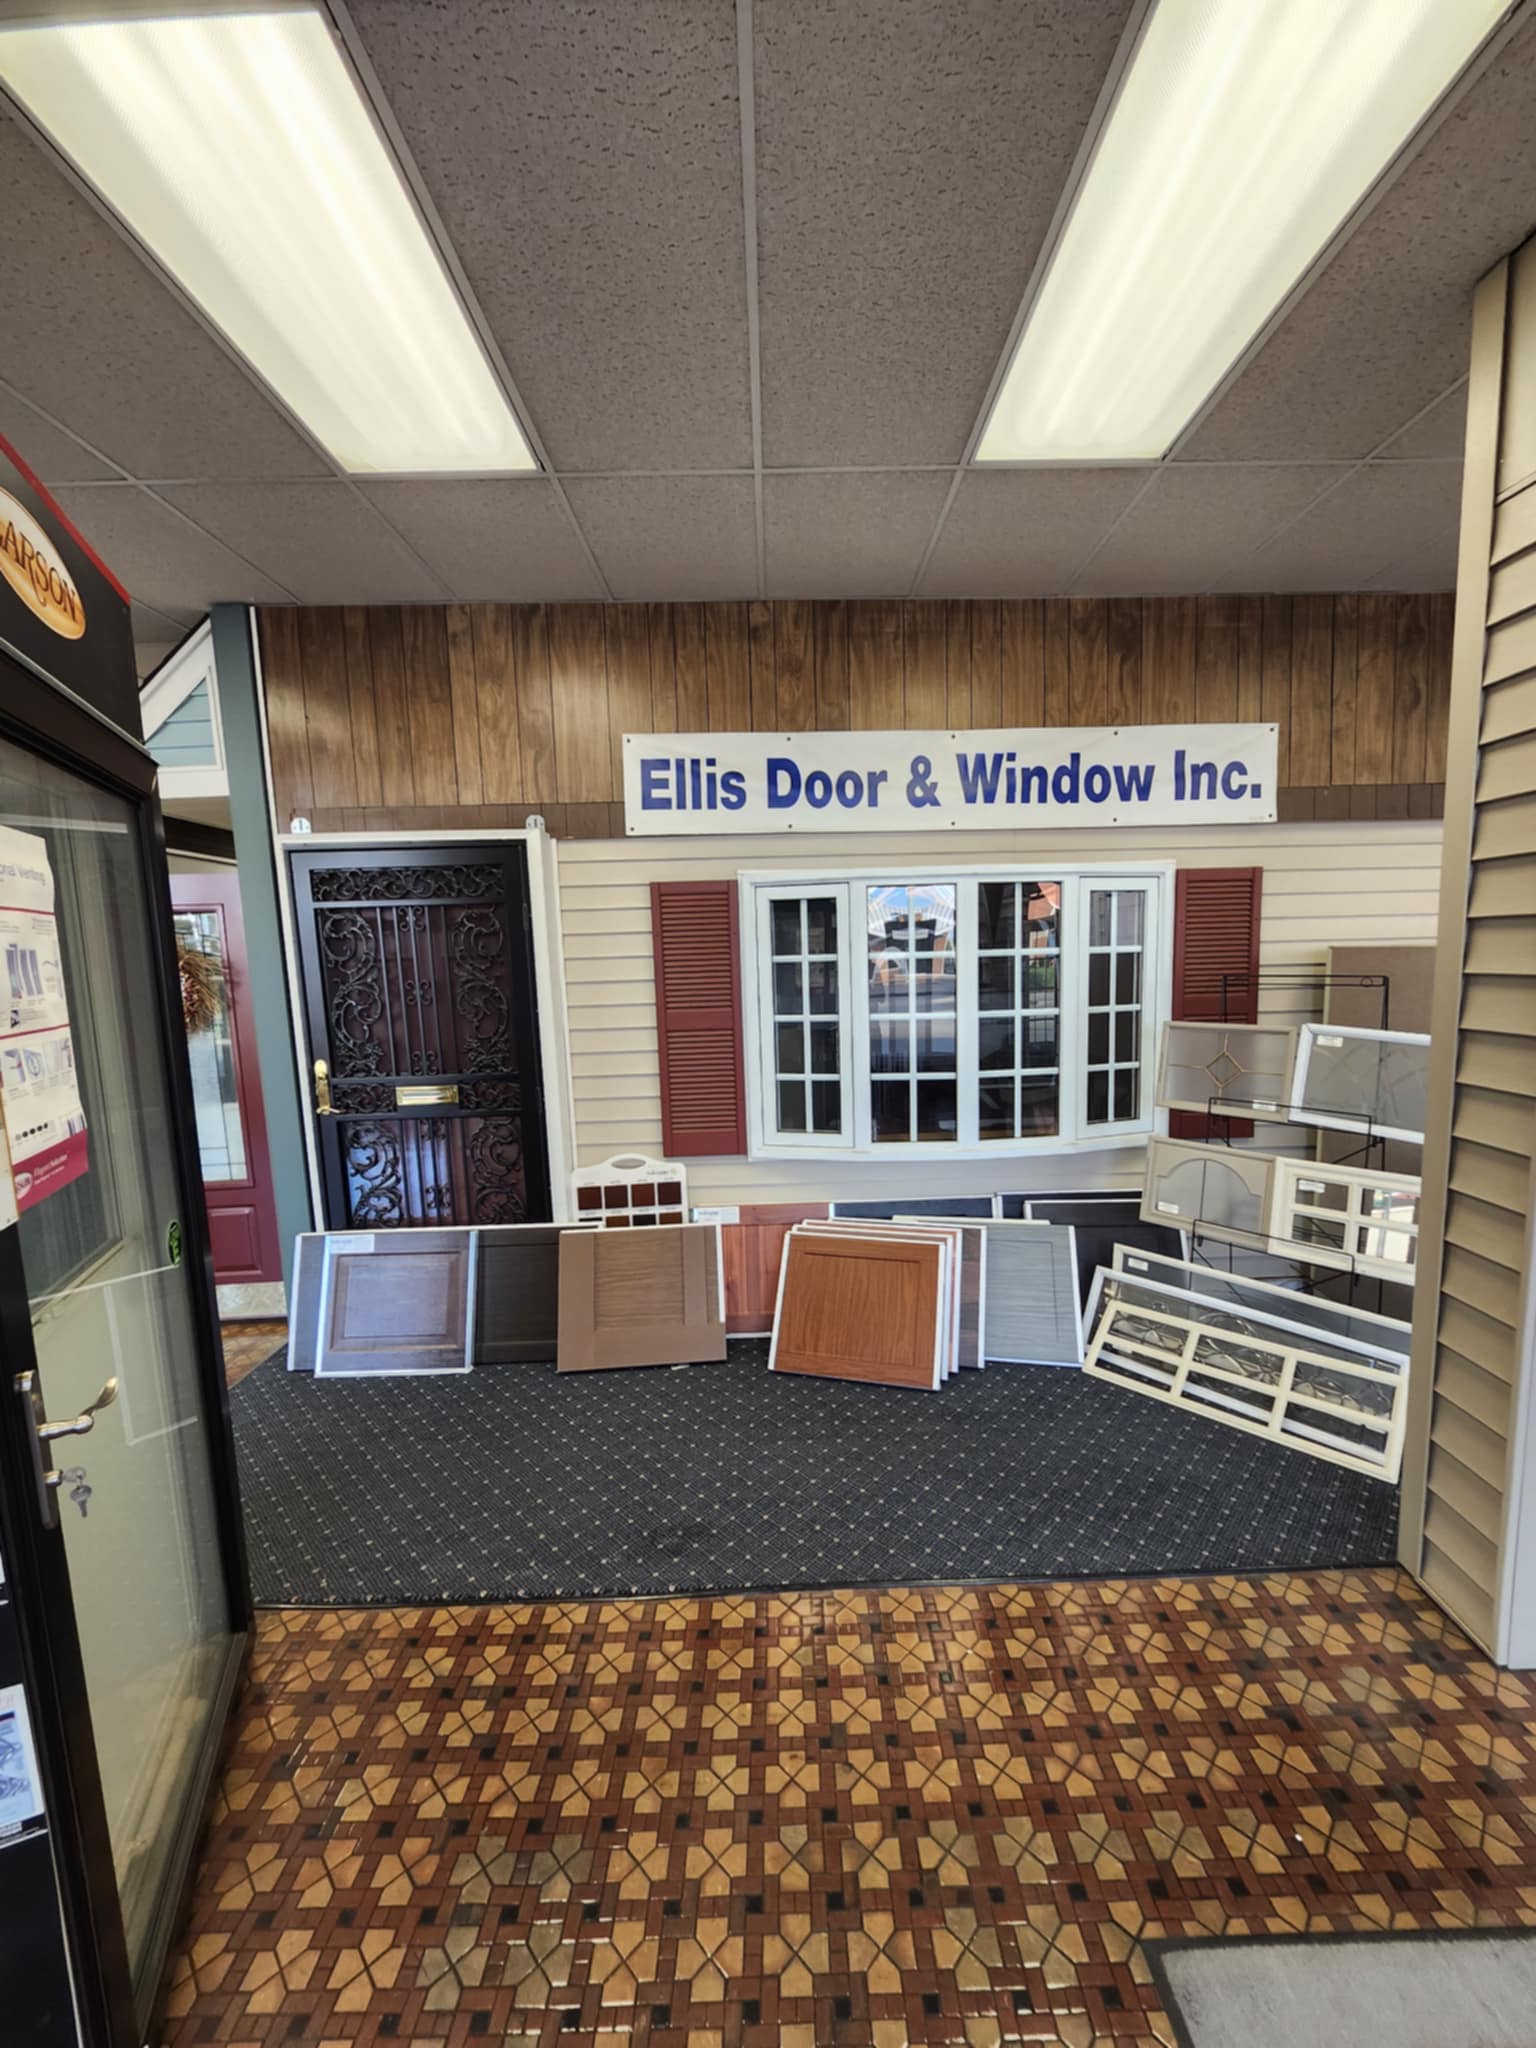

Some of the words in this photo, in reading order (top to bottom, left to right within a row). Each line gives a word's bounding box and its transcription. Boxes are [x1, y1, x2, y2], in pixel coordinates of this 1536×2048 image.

[641, 758, 747, 811] Ellis
[768, 757, 888, 810] Door
[907, 756, 940, 809] &
[956, 751, 1153, 805] Window
[1174, 750, 1260, 802] Inc.
